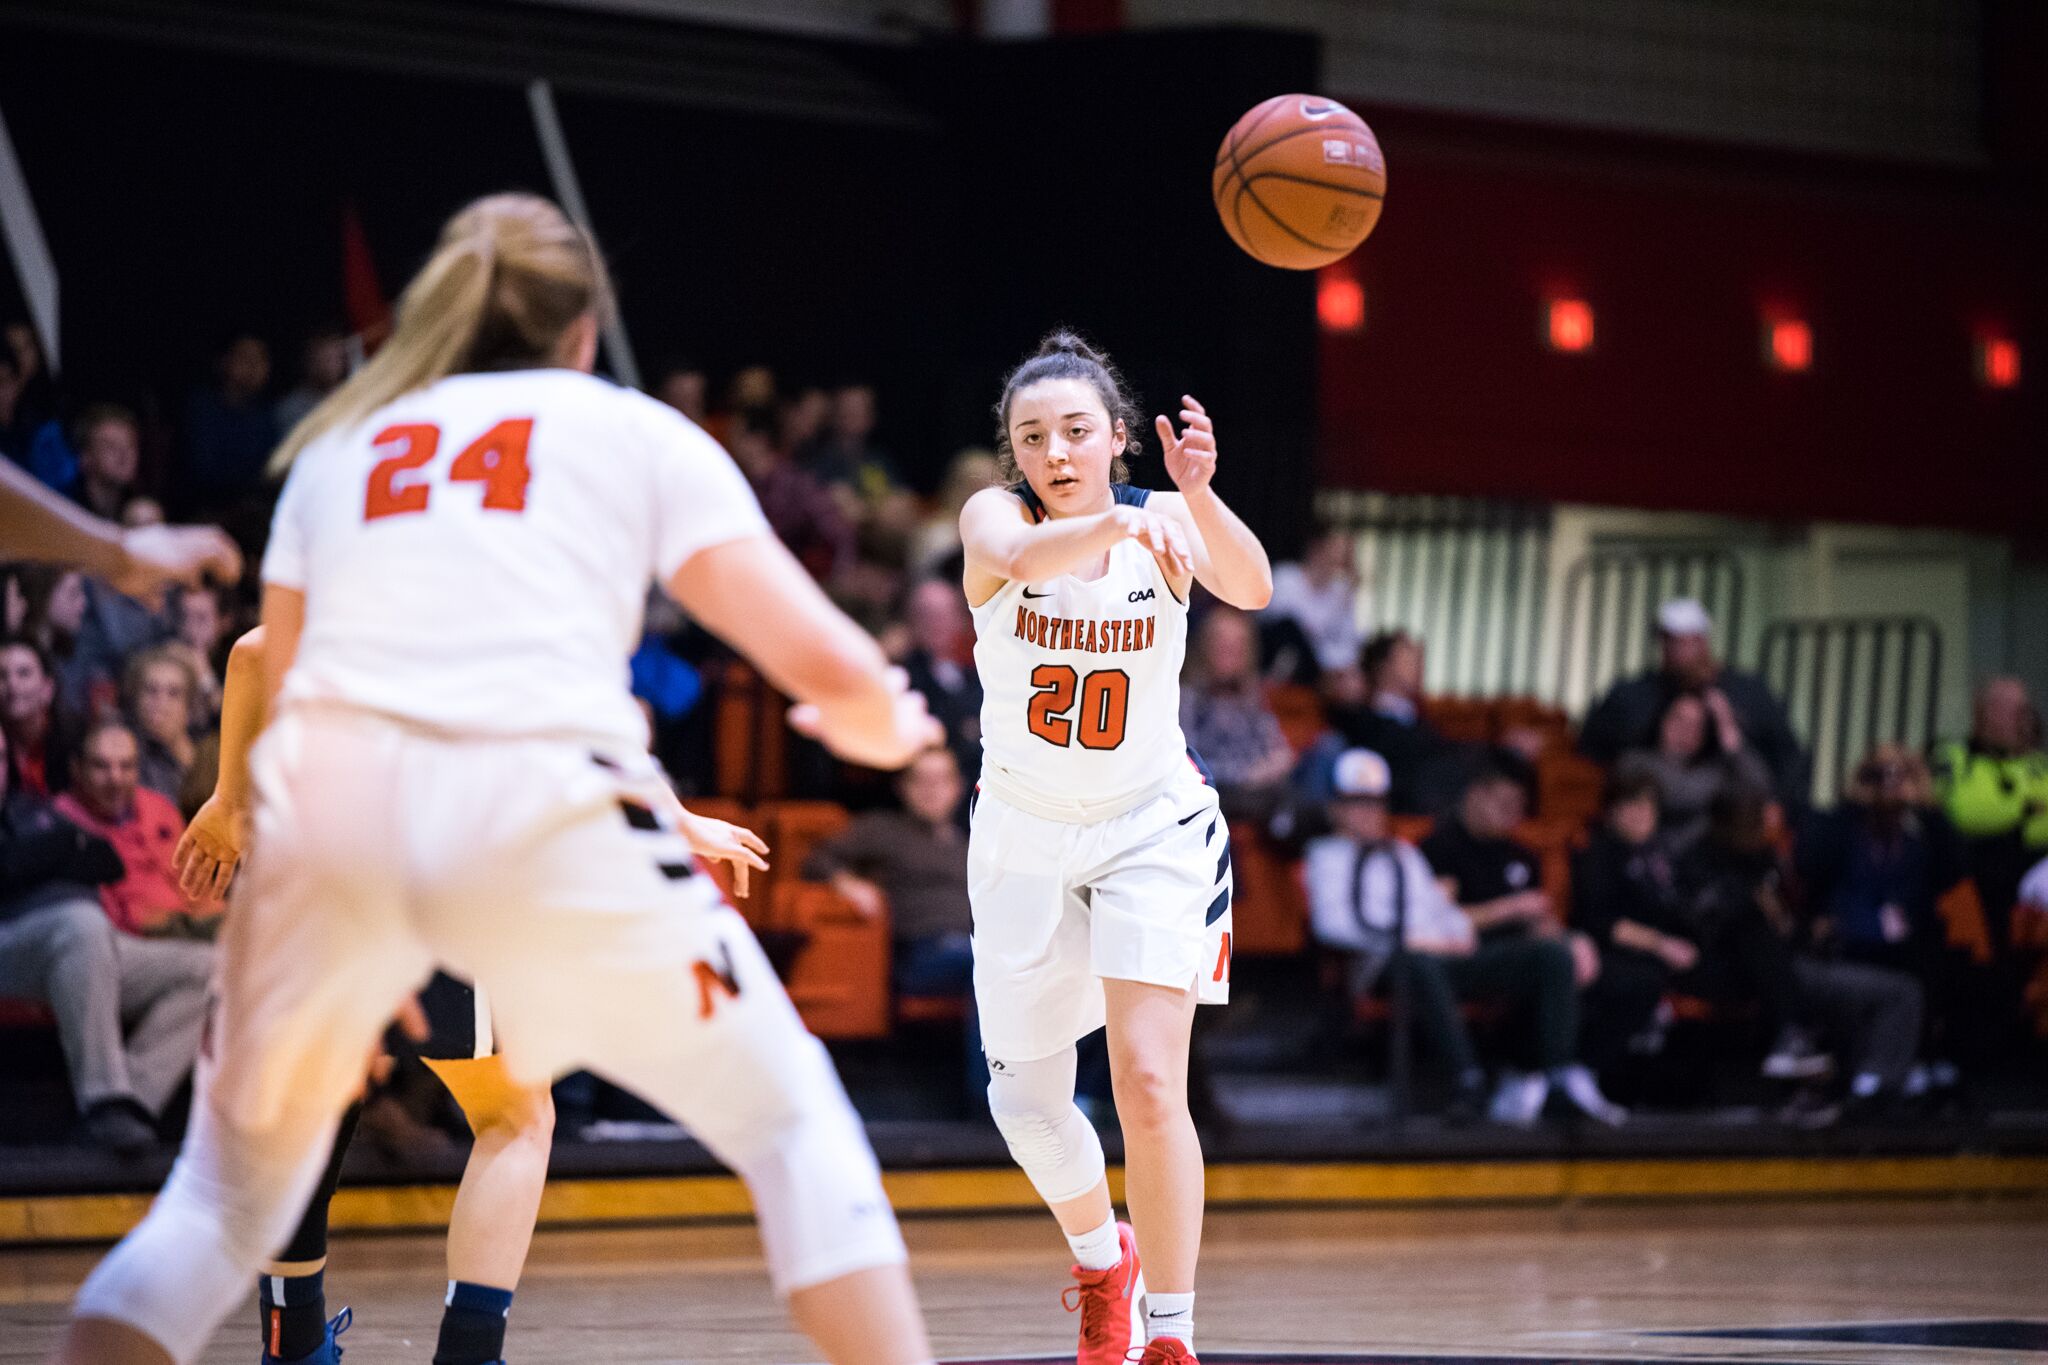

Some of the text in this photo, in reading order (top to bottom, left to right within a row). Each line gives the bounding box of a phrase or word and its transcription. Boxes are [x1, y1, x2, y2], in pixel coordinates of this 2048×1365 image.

[364, 418, 534, 522] 24
[1014, 605, 1156, 654] NORTHEASTERN
[1128, 588, 1156, 603] CAA
[1027, 663, 1131, 751] 20
[691, 941, 741, 1020] N
